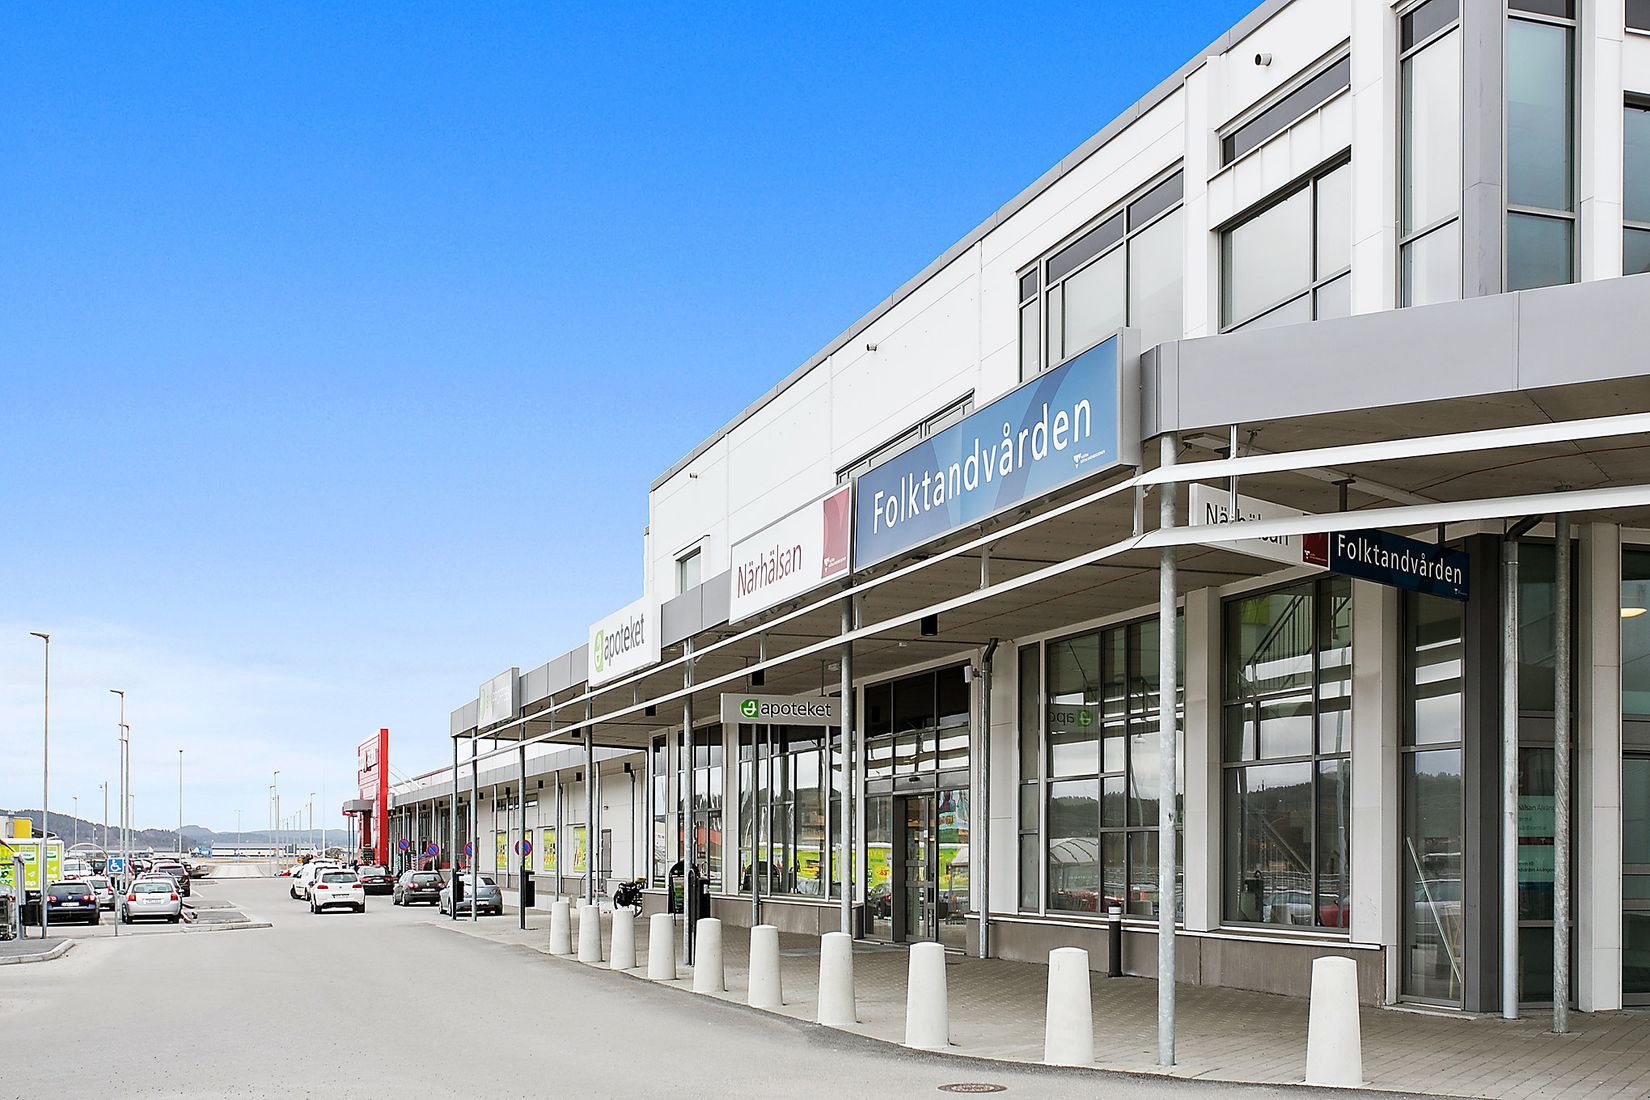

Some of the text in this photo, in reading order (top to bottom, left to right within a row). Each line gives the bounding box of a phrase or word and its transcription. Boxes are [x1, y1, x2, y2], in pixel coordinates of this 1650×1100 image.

[872, 398, 1092, 535] Folktandvården
[737, 543, 802, 599] Närhälsan
[1337, 533, 1462, 585] Folktandvården
[603, 612, 645, 668] apoteket
[760, 700, 832, 719] apoteket
